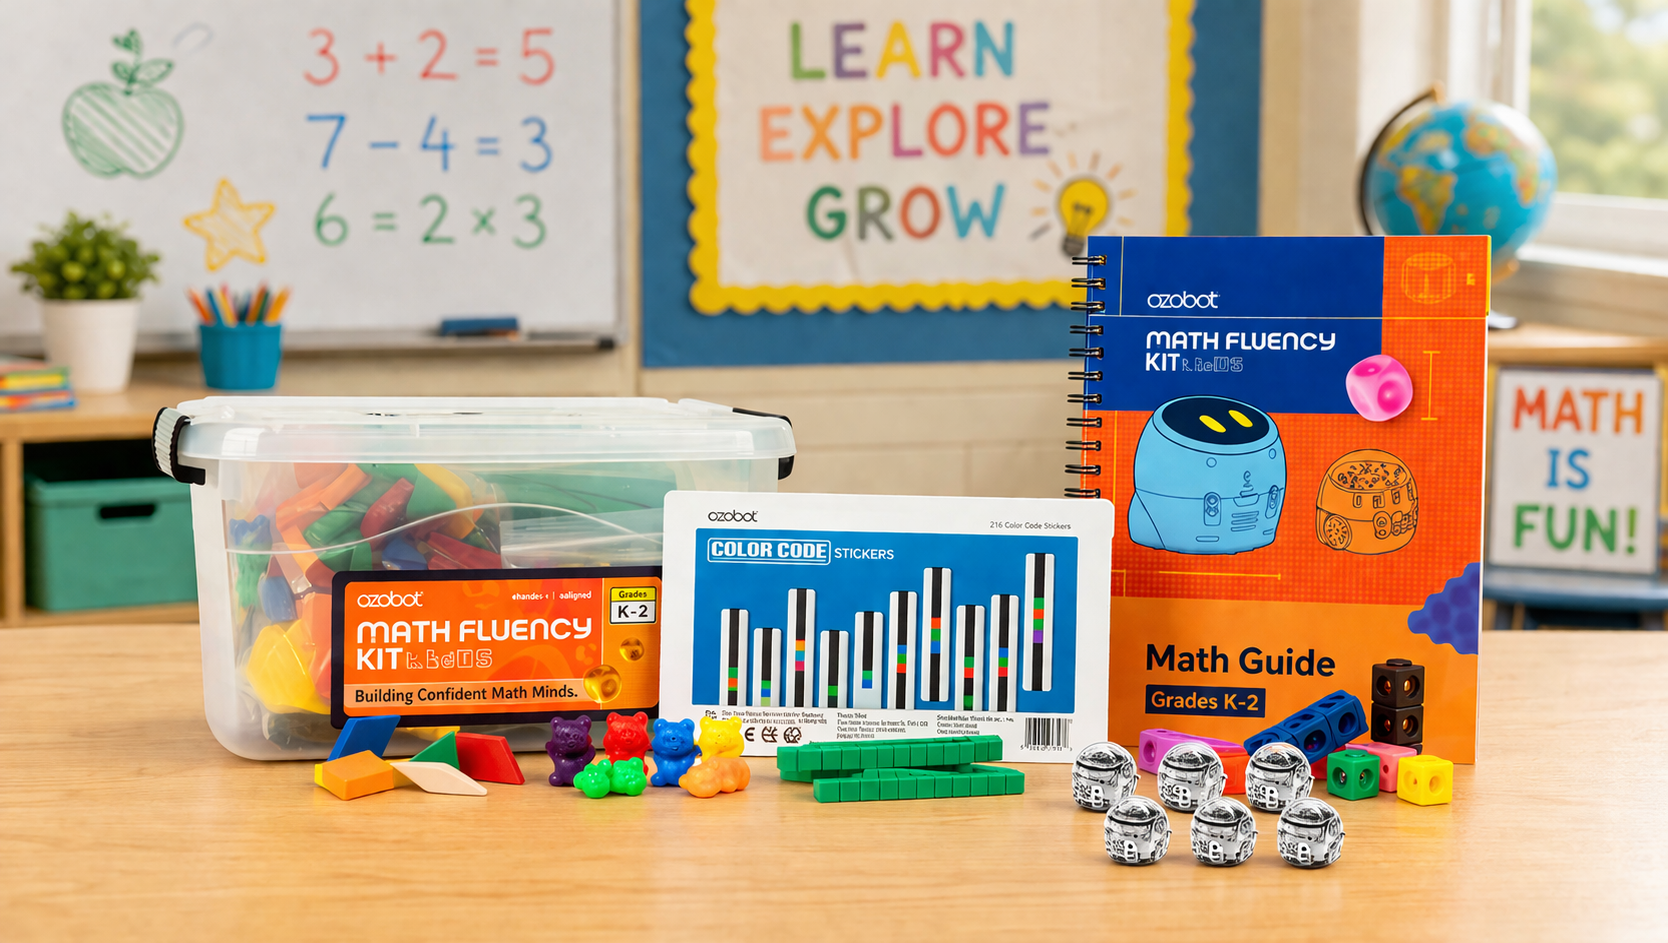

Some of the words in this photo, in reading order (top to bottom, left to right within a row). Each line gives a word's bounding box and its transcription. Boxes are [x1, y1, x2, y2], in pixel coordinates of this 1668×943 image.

[303, 28, 340, 86] 3
[364, 41, 397, 75] +
[417, 29, 458, 81] 2
[474, 47, 499, 67] =
[519, 28, 555, 86] 5
[790, 19, 1015, 80] LEARN
[759, 101, 1051, 162] EXPLORE
[305, 114, 347, 170] 7
[419, 115, 456, 172] 4
[476, 136, 500, 156] =
[519, 116, 553, 173] 3
[314, 192, 349, 247] 6
[373, 211, 397, 231] =
[420, 194, 456, 245] 2
[512, 194, 547, 249] 3
[806, 183, 1006, 241] GROW
[1147, 290, 1219, 309] ozobot
[1146, 331, 1219, 350] MATH
[1225, 332, 1336, 351] FLUENCY
[1145, 352, 1180, 372] KIT
[1512, 385, 1643, 435] MATH
[1547, 448, 1591, 490] IS
[708, 510, 758, 523] ozobot
[1004, 521, 1023, 529] Color
[1024, 522, 1042, 530] Code
[1043, 522, 1072, 530] Stickers
[1514, 504, 1637, 555] FUN!
[711, 541, 773, 558] COLOR
[777, 542, 828, 559] CODE
[834, 548, 895, 560] STICKERS
[357, 591, 424, 608] ozobot
[618, 590, 648, 598] Grades
[618, 605, 648, 618] K-2
[357, 620, 451, 643] MATH
[459, 618, 592, 643] FLUENCY
[357, 647, 404, 670] KIT
[1146, 643, 1230, 673] Math
[1239, 647, 1336, 677] Guide
[355, 689, 413, 705] Building
[417, 687, 487, 701] Confident
[491, 686, 527, 699] Math
[531, 684, 578, 698] Minds.
[1151, 690, 1217, 710] Grades
[1224, 694, 1259, 711] K-2
